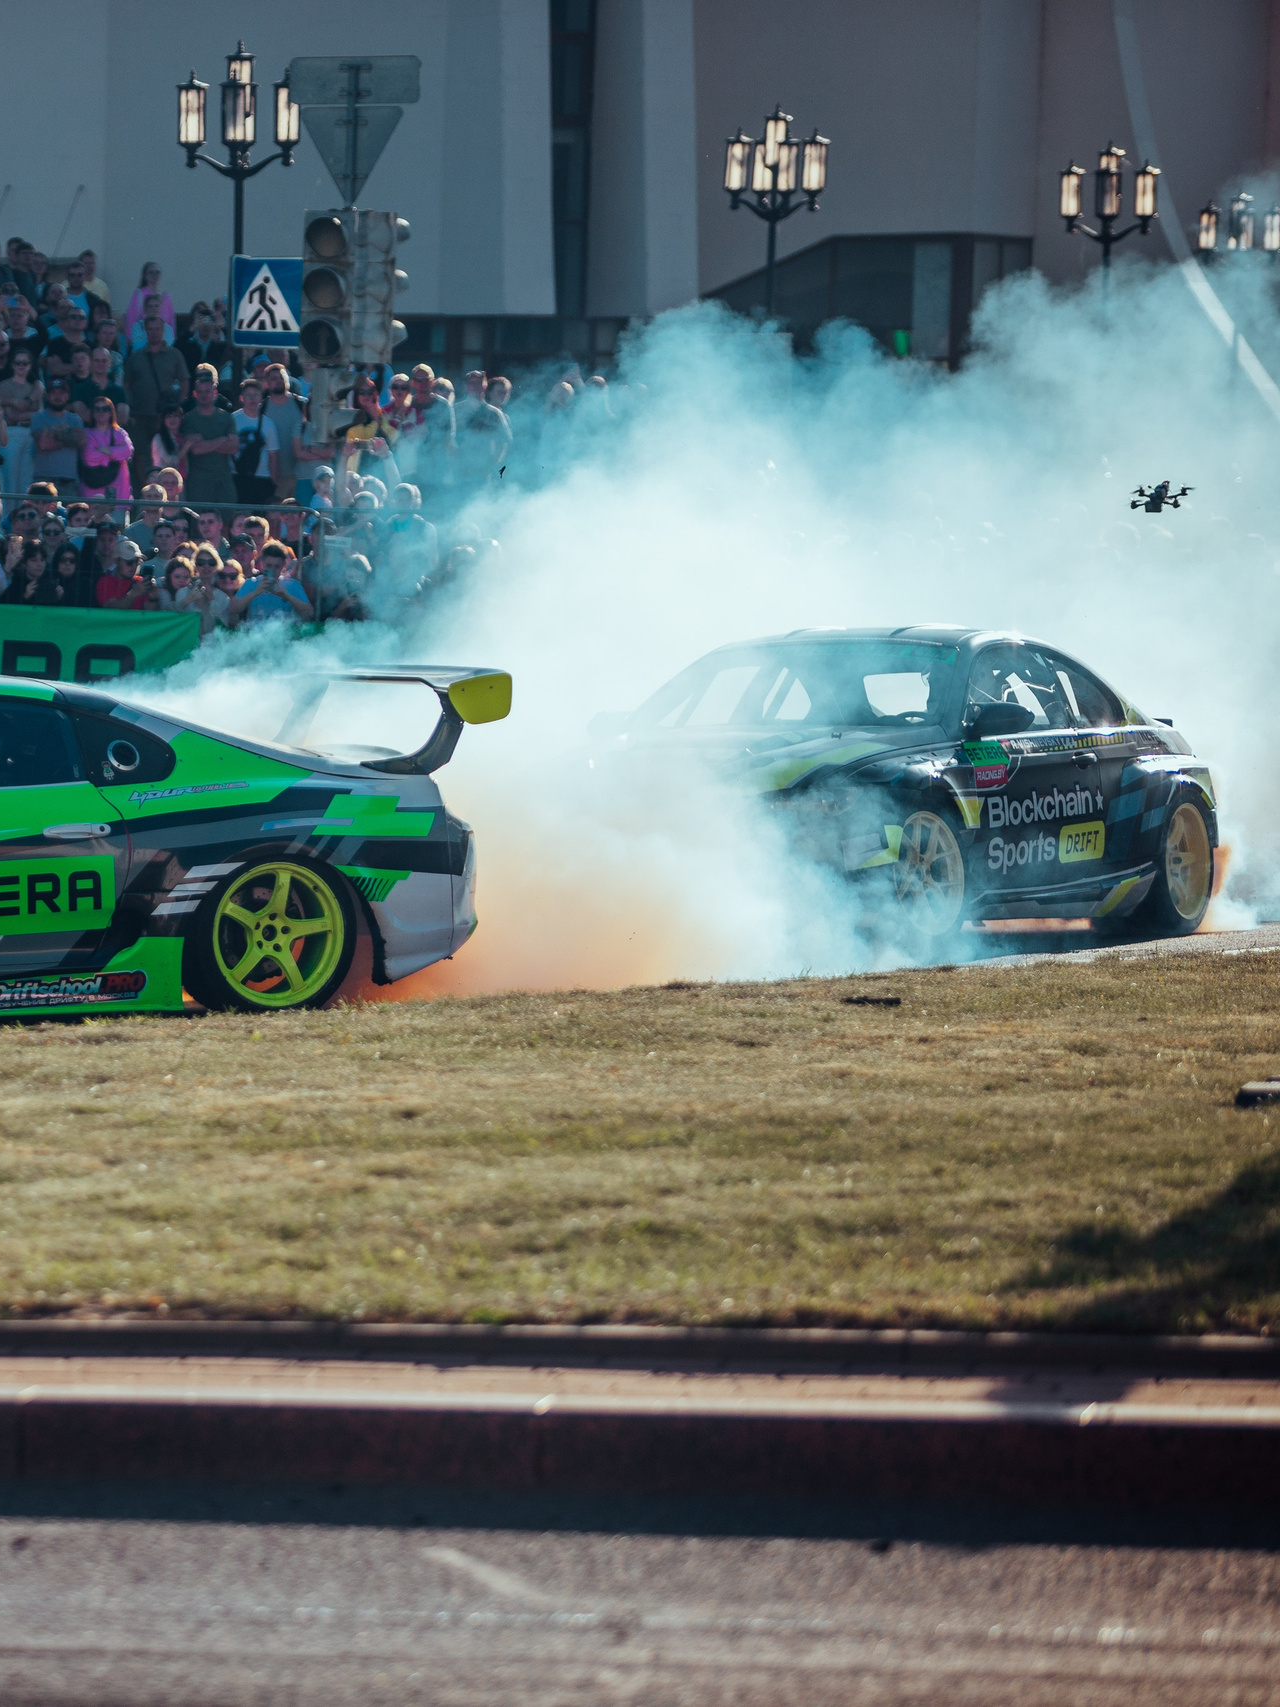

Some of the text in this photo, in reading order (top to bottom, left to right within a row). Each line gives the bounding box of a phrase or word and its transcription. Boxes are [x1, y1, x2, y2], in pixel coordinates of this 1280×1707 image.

[987, 784, 1094, 828] Blockchain
[988, 830, 1100, 874] Sports DRIFT
